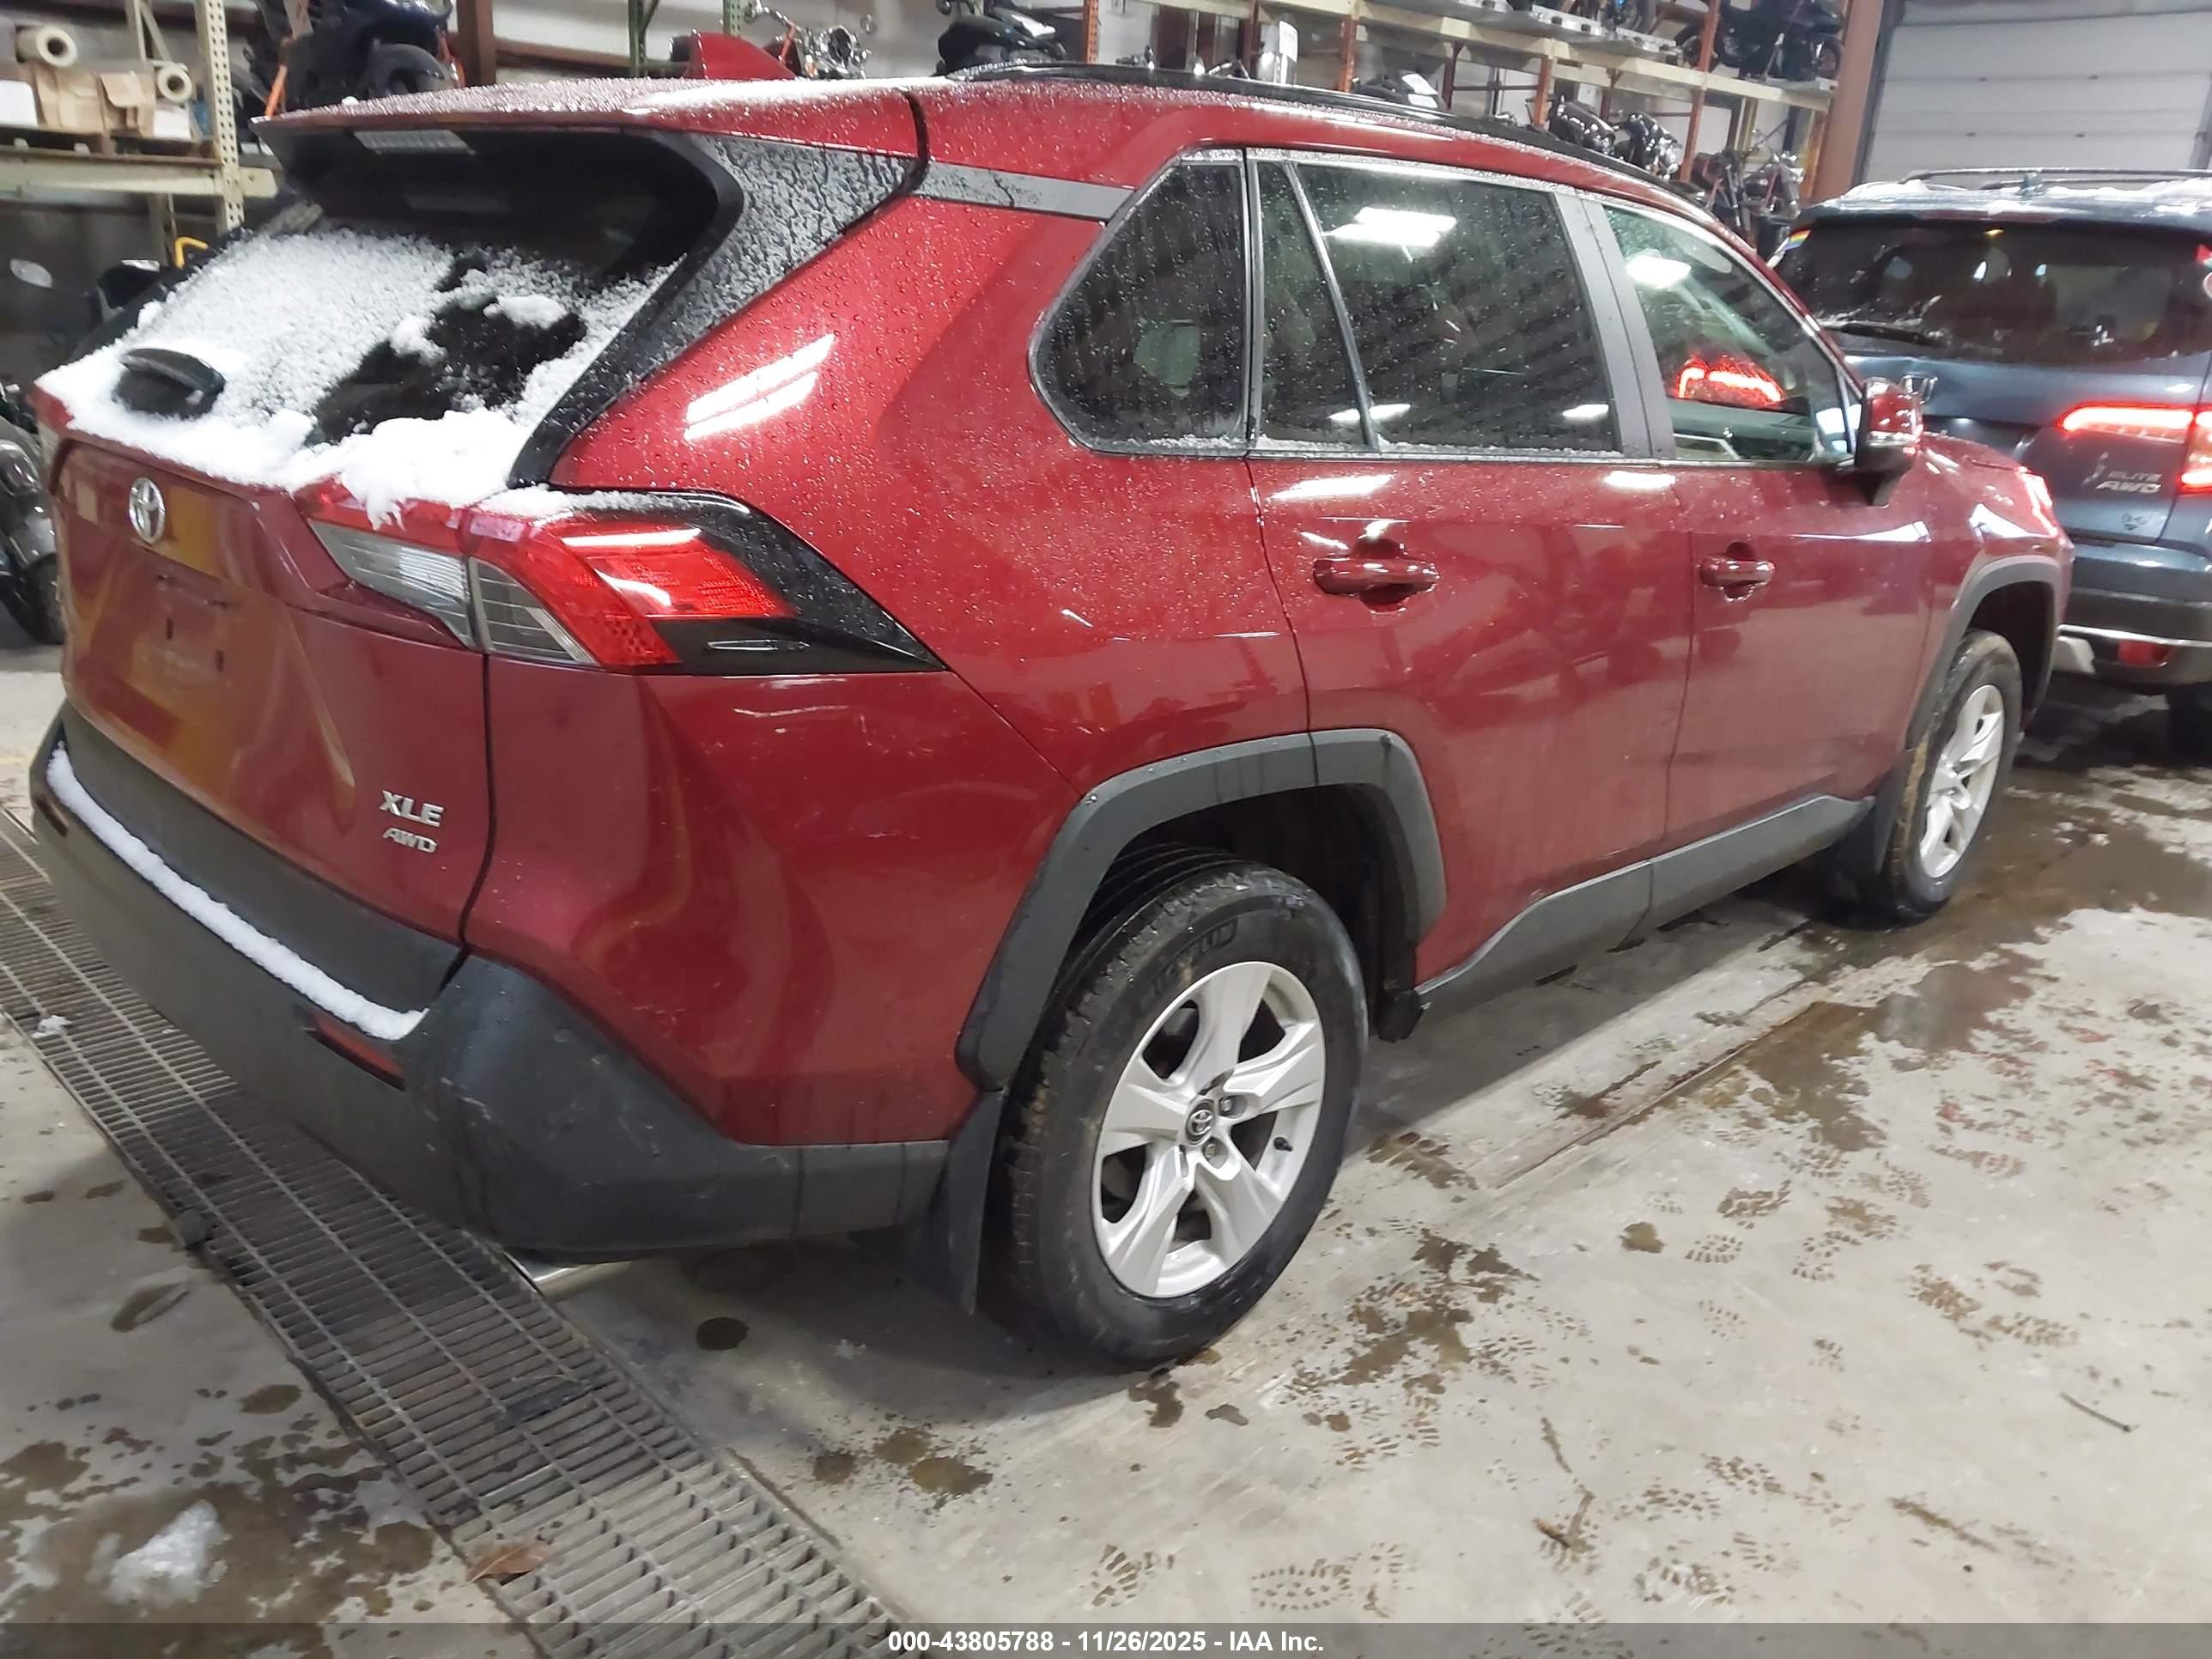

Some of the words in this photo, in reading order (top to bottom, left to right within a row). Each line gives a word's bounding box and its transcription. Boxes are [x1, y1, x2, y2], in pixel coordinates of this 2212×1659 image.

[2095, 480, 2162, 494] AWD
[379, 789, 445, 827] XLE
[382, 827, 437, 853] AWD
